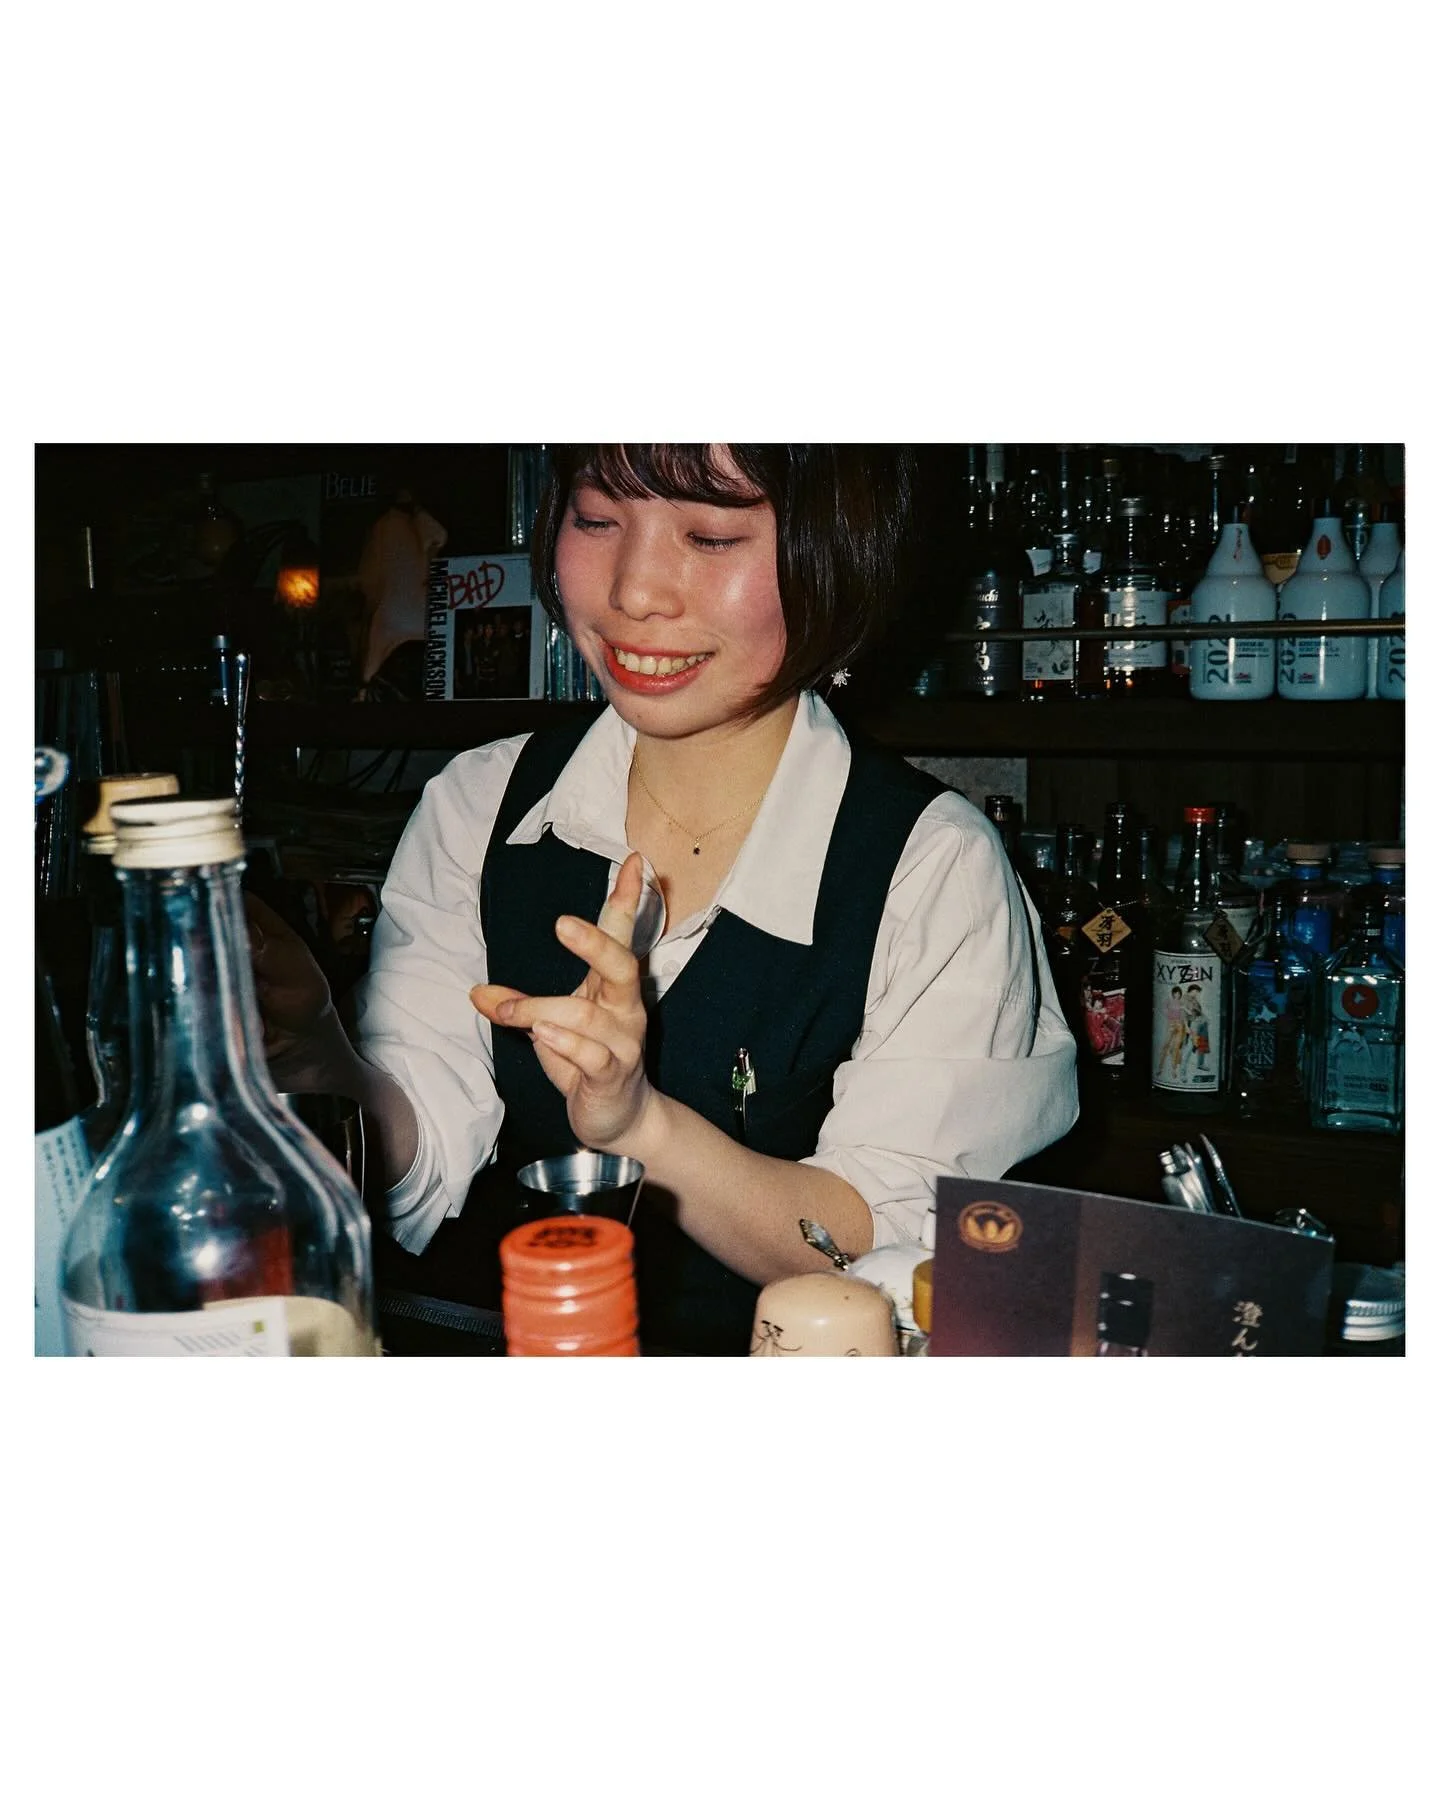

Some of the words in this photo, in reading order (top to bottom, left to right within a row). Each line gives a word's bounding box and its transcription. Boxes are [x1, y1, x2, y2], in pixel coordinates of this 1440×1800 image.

[428, 559, 449, 628] MICHAEL
[445, 560, 505, 609] BAD
[424, 631, 447, 700] JACKSON
[1231, 1300, 1263, 1357] 澄ん
